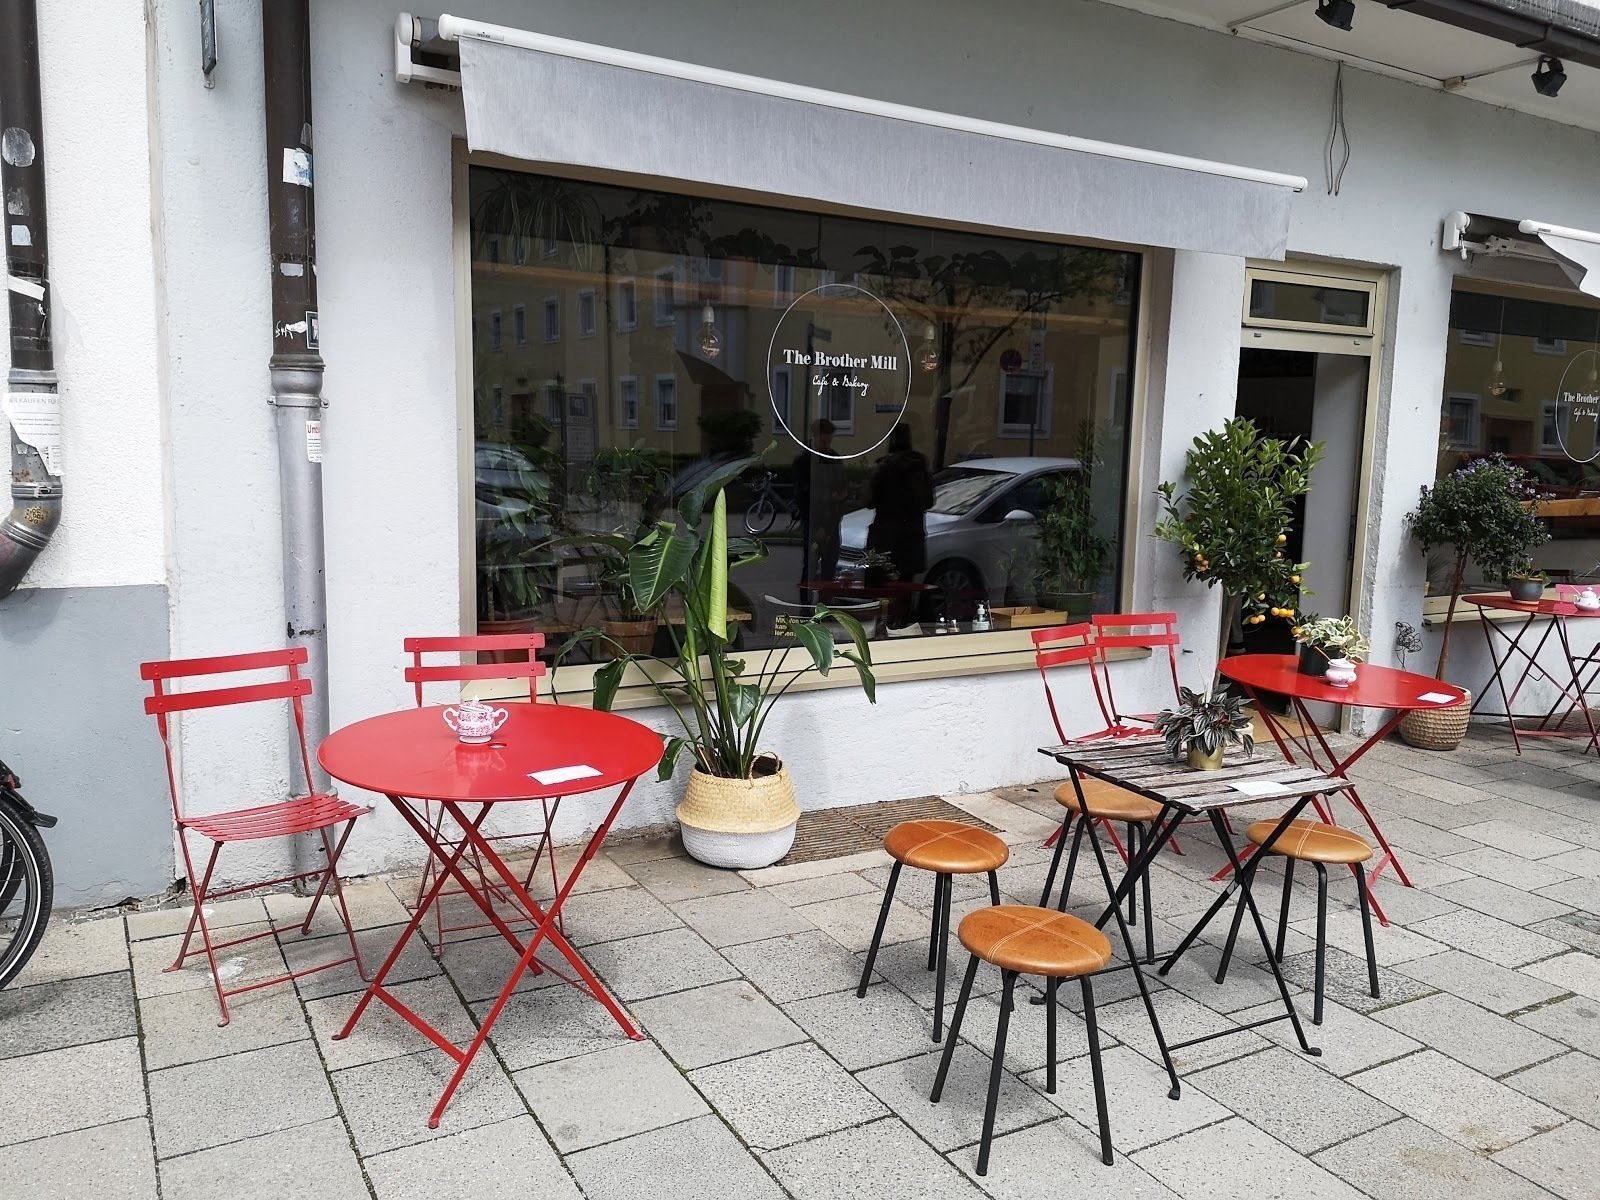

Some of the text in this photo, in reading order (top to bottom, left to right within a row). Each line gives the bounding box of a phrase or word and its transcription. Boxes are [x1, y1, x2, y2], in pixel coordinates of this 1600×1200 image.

[783, 349, 897, 371] The Brother Mill
[812, 373, 869, 397] Café & Bakery
[1563, 391, 1599, 404] The Brother
